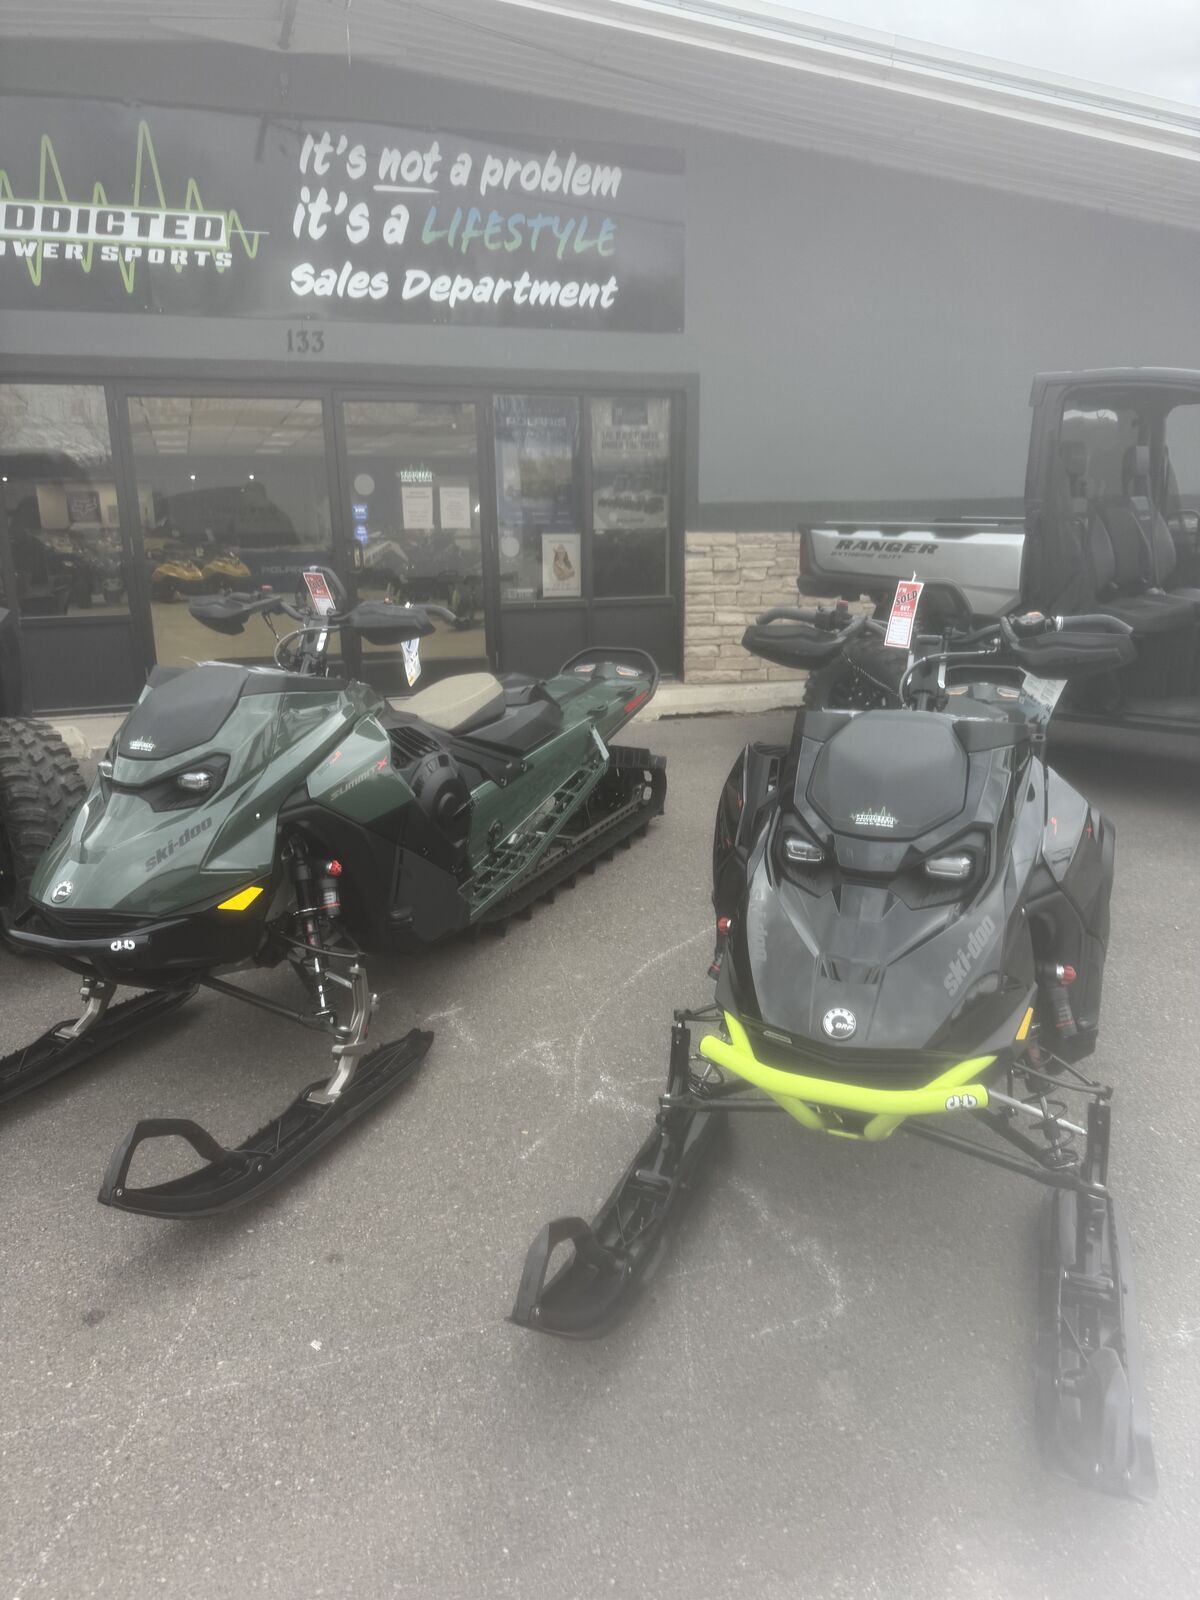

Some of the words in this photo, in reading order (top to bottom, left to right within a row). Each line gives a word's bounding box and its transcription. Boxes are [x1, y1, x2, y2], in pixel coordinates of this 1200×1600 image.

[300, 131, 367, 180] It's
[378, 141, 442, 184] not
[450, 152, 472, 186] a
[480, 150, 622, 198] problem
[293, 186, 370, 244] it's
[383, 204, 410, 245] a
[421, 206, 617, 260] LIFESTYLE
[101, 245, 232, 267] SPORTS
[290, 260, 389, 300] Sales
[402, 271, 618, 309] Department
[286, 328, 325, 353] 133
[835, 538, 939, 554] RANGER
[895, 590, 918, 606] SOLD
[145, 816, 213, 873] ski-doo
[943, 915, 996, 997] ski-doo
